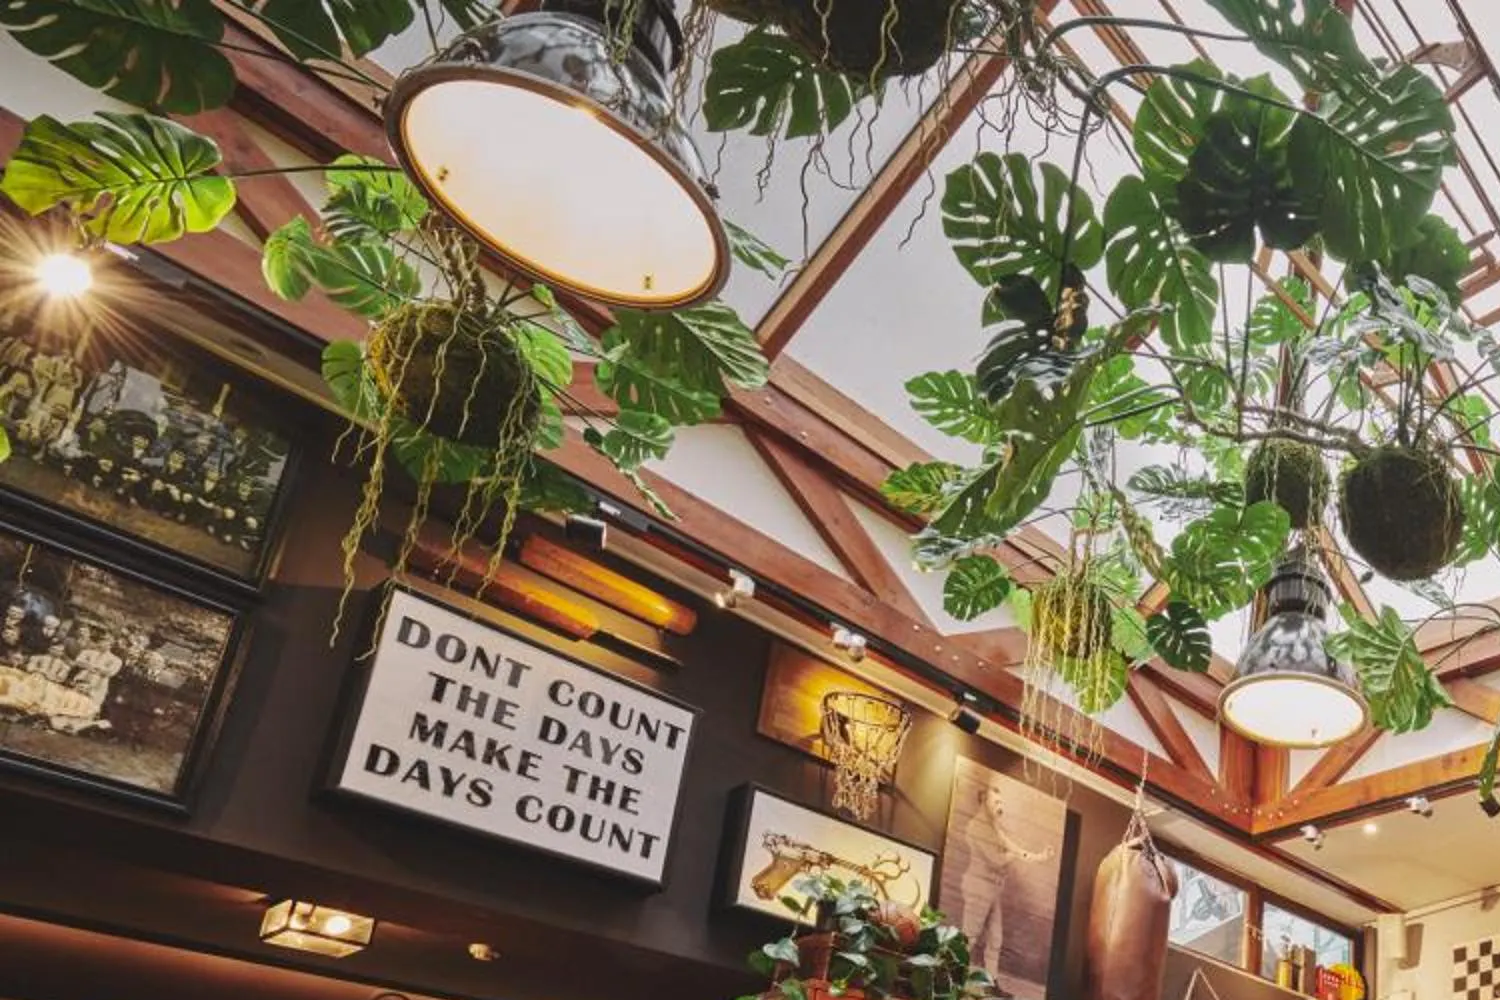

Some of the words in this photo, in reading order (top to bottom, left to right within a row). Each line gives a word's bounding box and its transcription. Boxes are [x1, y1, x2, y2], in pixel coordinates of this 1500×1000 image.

[397, 615, 532, 689] DONT
[548, 679, 686, 750] COUNT
[428, 671, 521, 731] THE
[538, 715, 645, 775] DAYS
[363, 743, 494, 808] DAYS
[515, 795, 661, 860] COUNT
[408, 712, 543, 782] MAKE
[563, 764, 642, 816] THE
